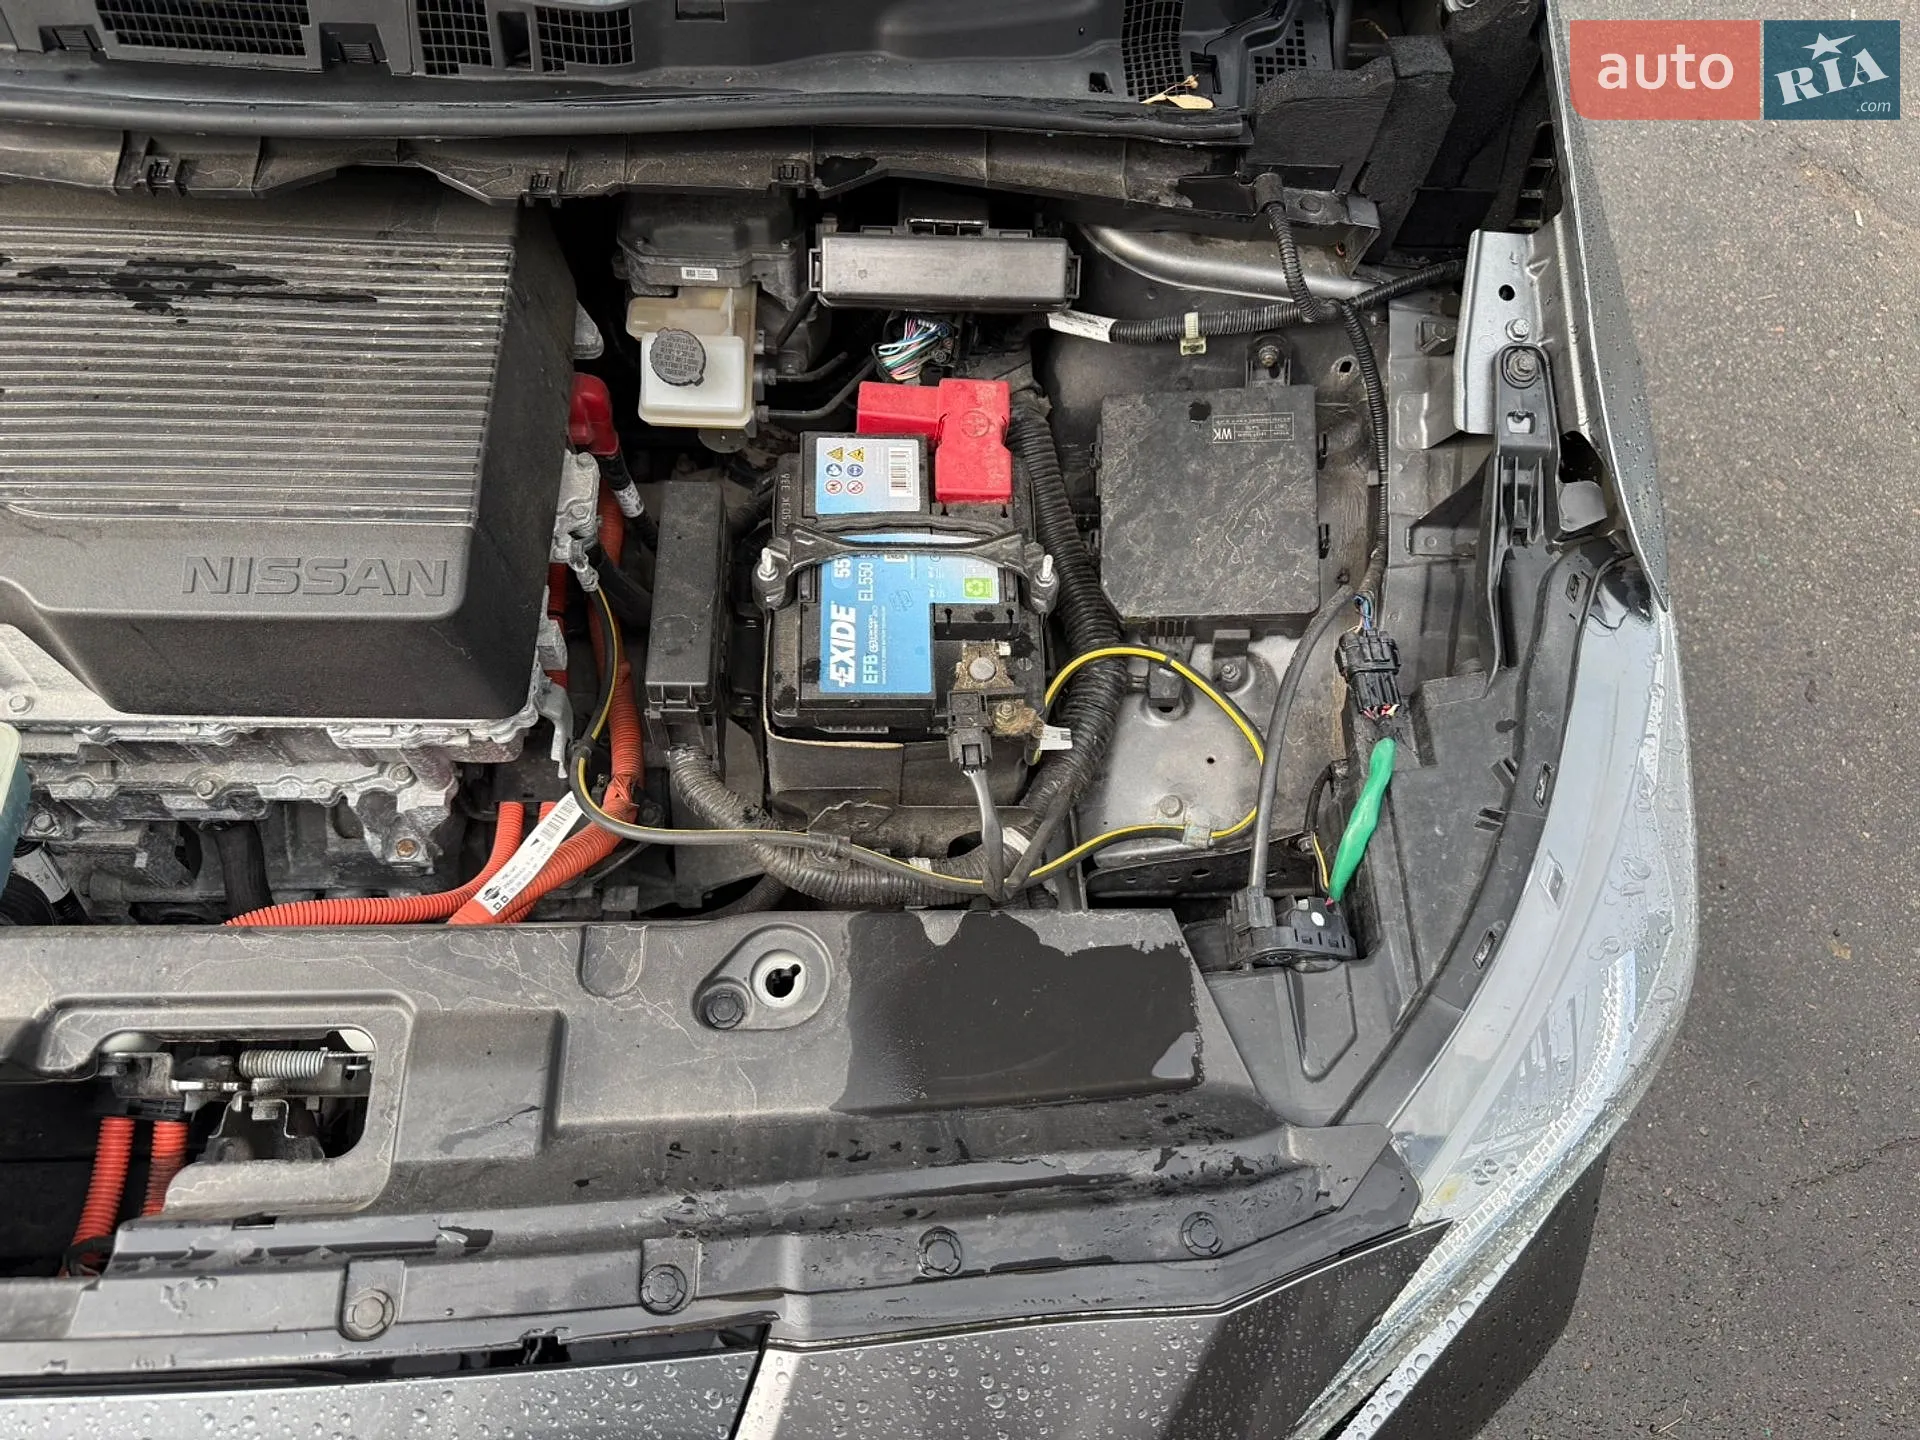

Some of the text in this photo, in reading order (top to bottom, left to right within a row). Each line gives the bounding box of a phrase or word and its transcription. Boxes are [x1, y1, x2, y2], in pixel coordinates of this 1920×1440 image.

[182, 556, 448, 597] NISSAN
[858, 562, 874, 602] EL550
[829, 604, 856, 688] EXIDE
[862, 655, 878, 685] EFB
